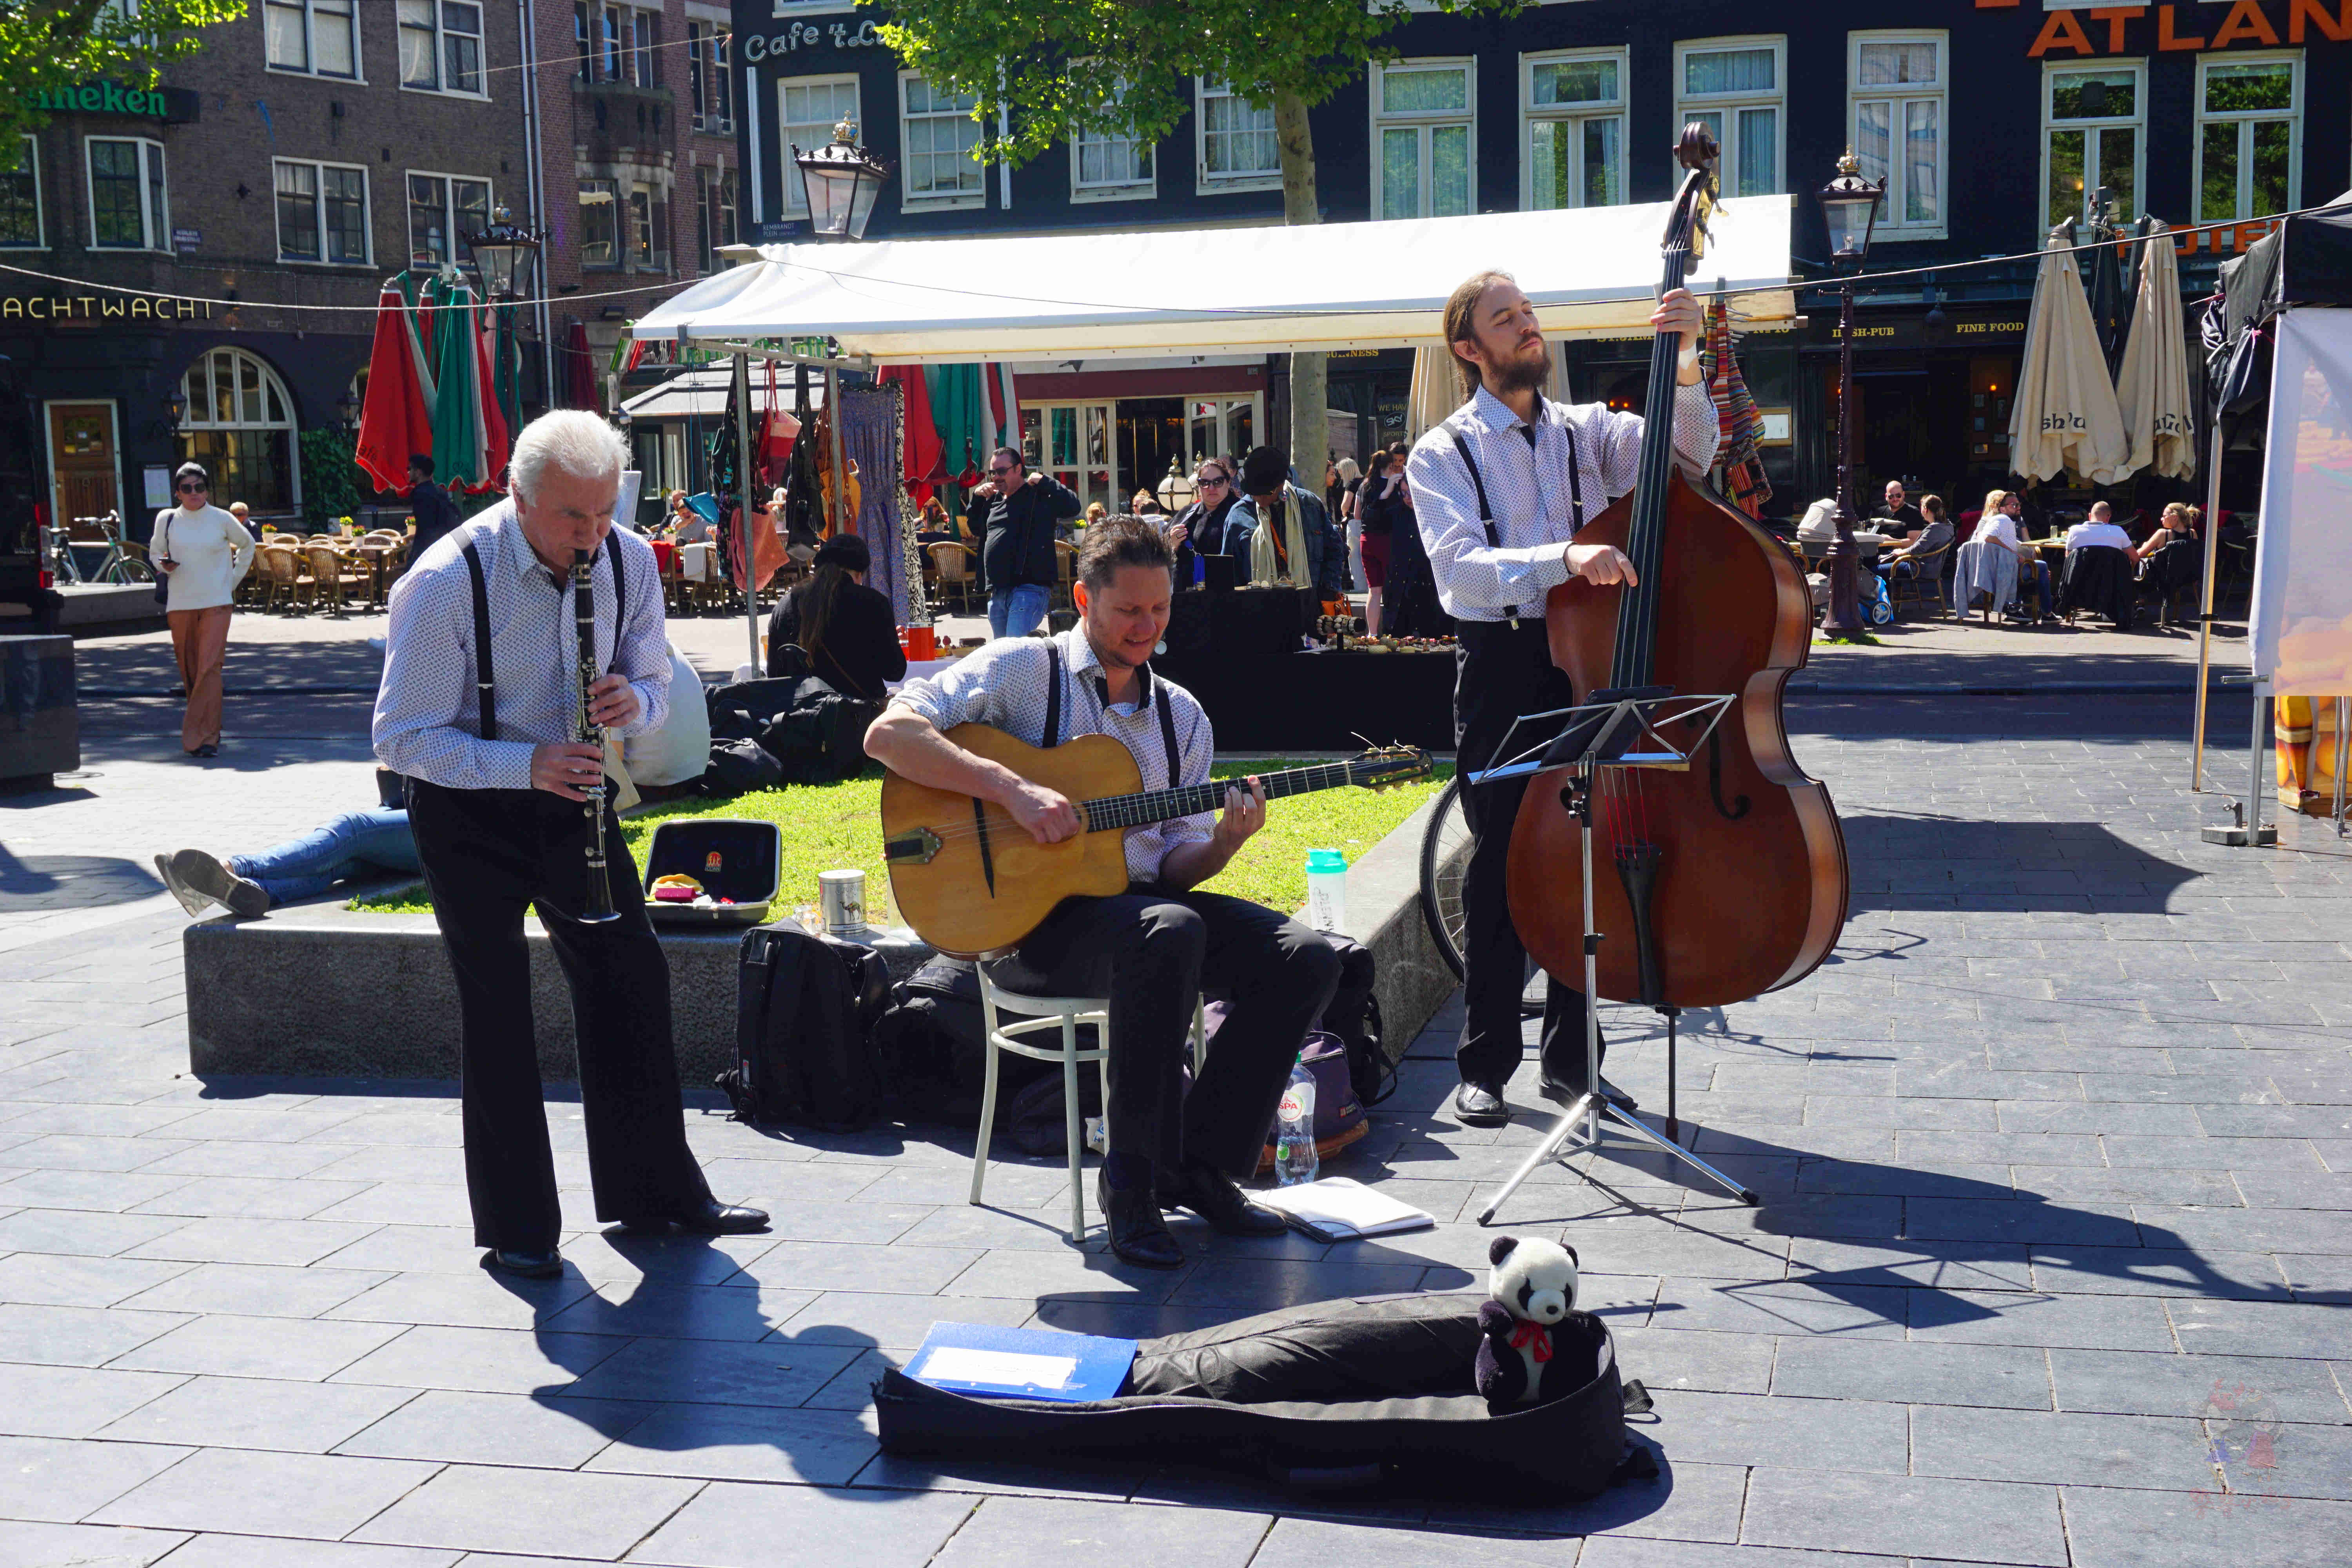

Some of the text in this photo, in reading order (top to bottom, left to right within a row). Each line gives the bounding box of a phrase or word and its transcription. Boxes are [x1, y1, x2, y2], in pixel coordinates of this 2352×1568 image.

[2027, 0, 2352, 57] ATLAN
[745, 22, 819, 62] Cafe
[1832, 327, 1894, 338] ISH-PUB
[1956, 322, 2024, 333] FINE FOOD
